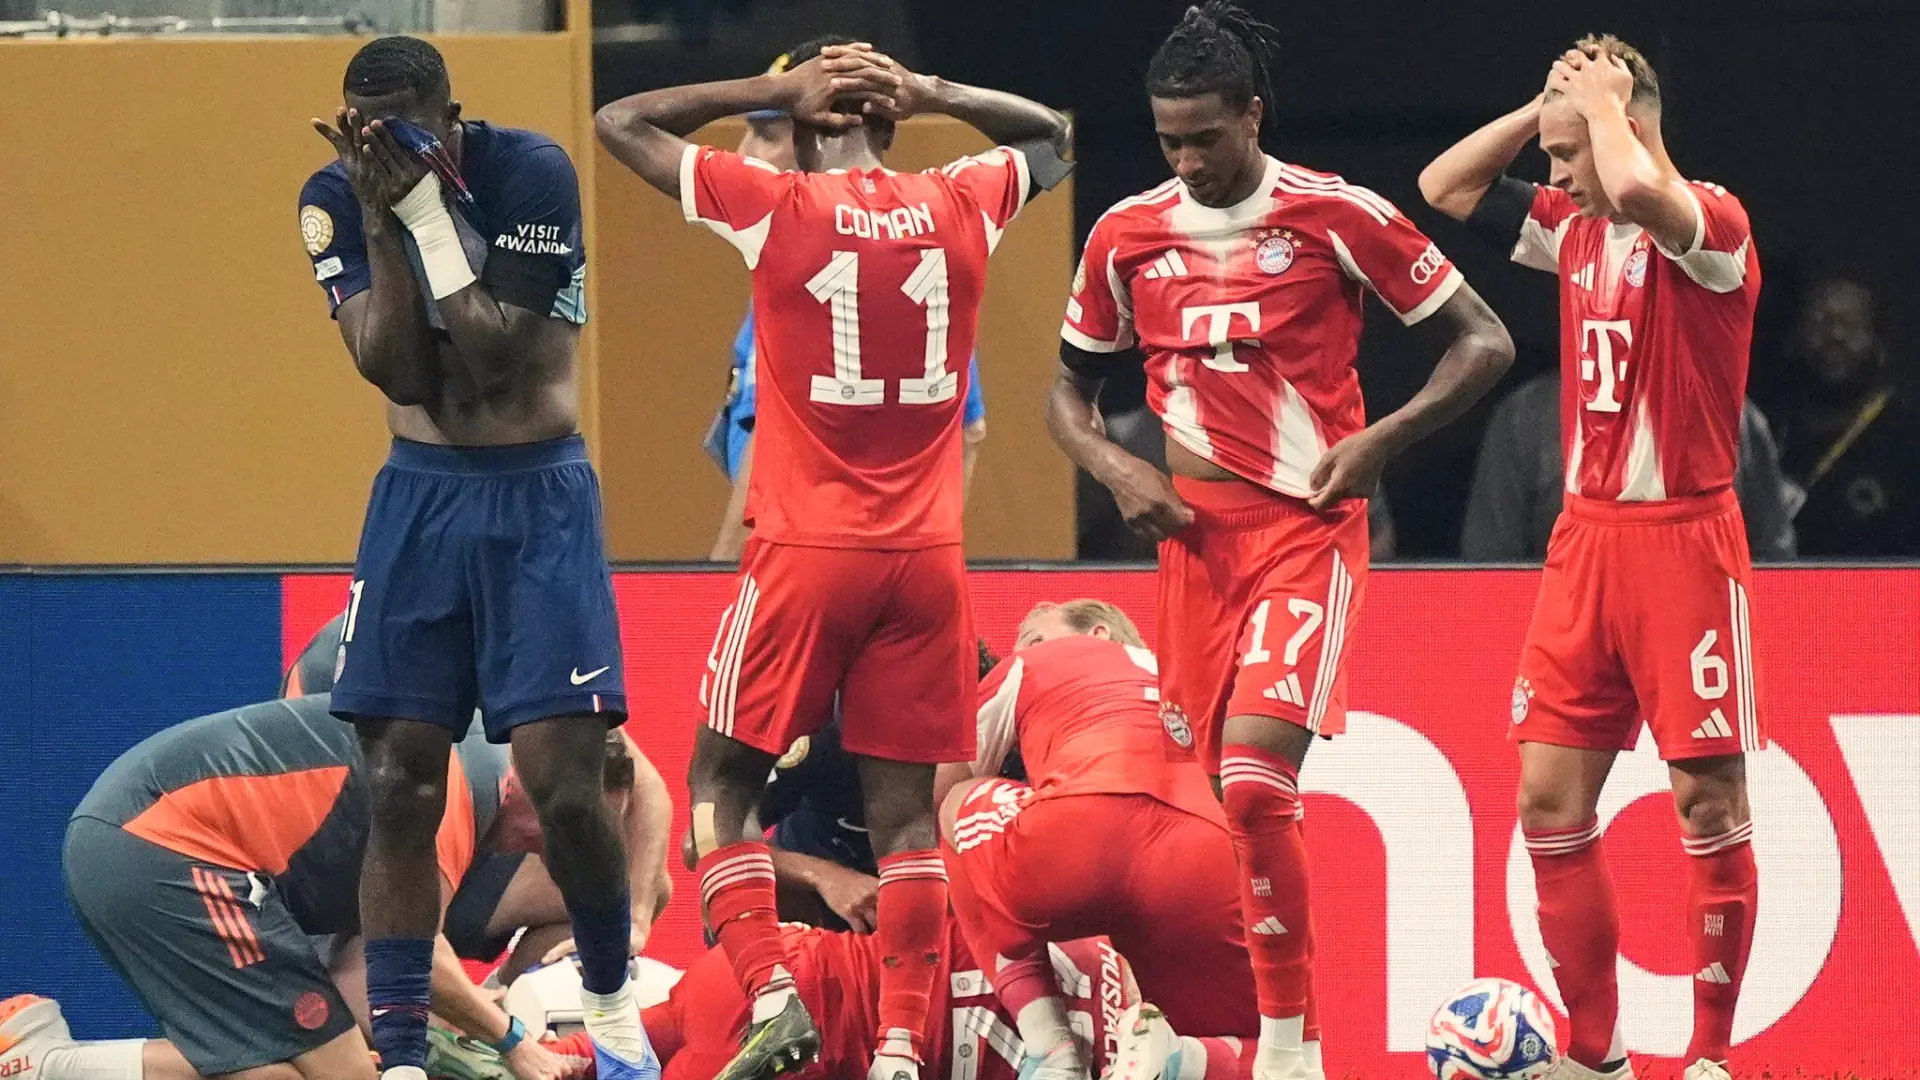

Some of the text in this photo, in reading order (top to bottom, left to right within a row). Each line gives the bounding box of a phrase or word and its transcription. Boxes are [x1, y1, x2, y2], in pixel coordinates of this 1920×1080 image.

[517, 224, 560, 240] VISIT
[834, 202, 936, 240] COMAN
[804, 248, 958, 406] 11
[340, 580, 365, 642] 1
[1243, 598, 1323, 667] 17
[1690, 629, 1729, 700] 6
